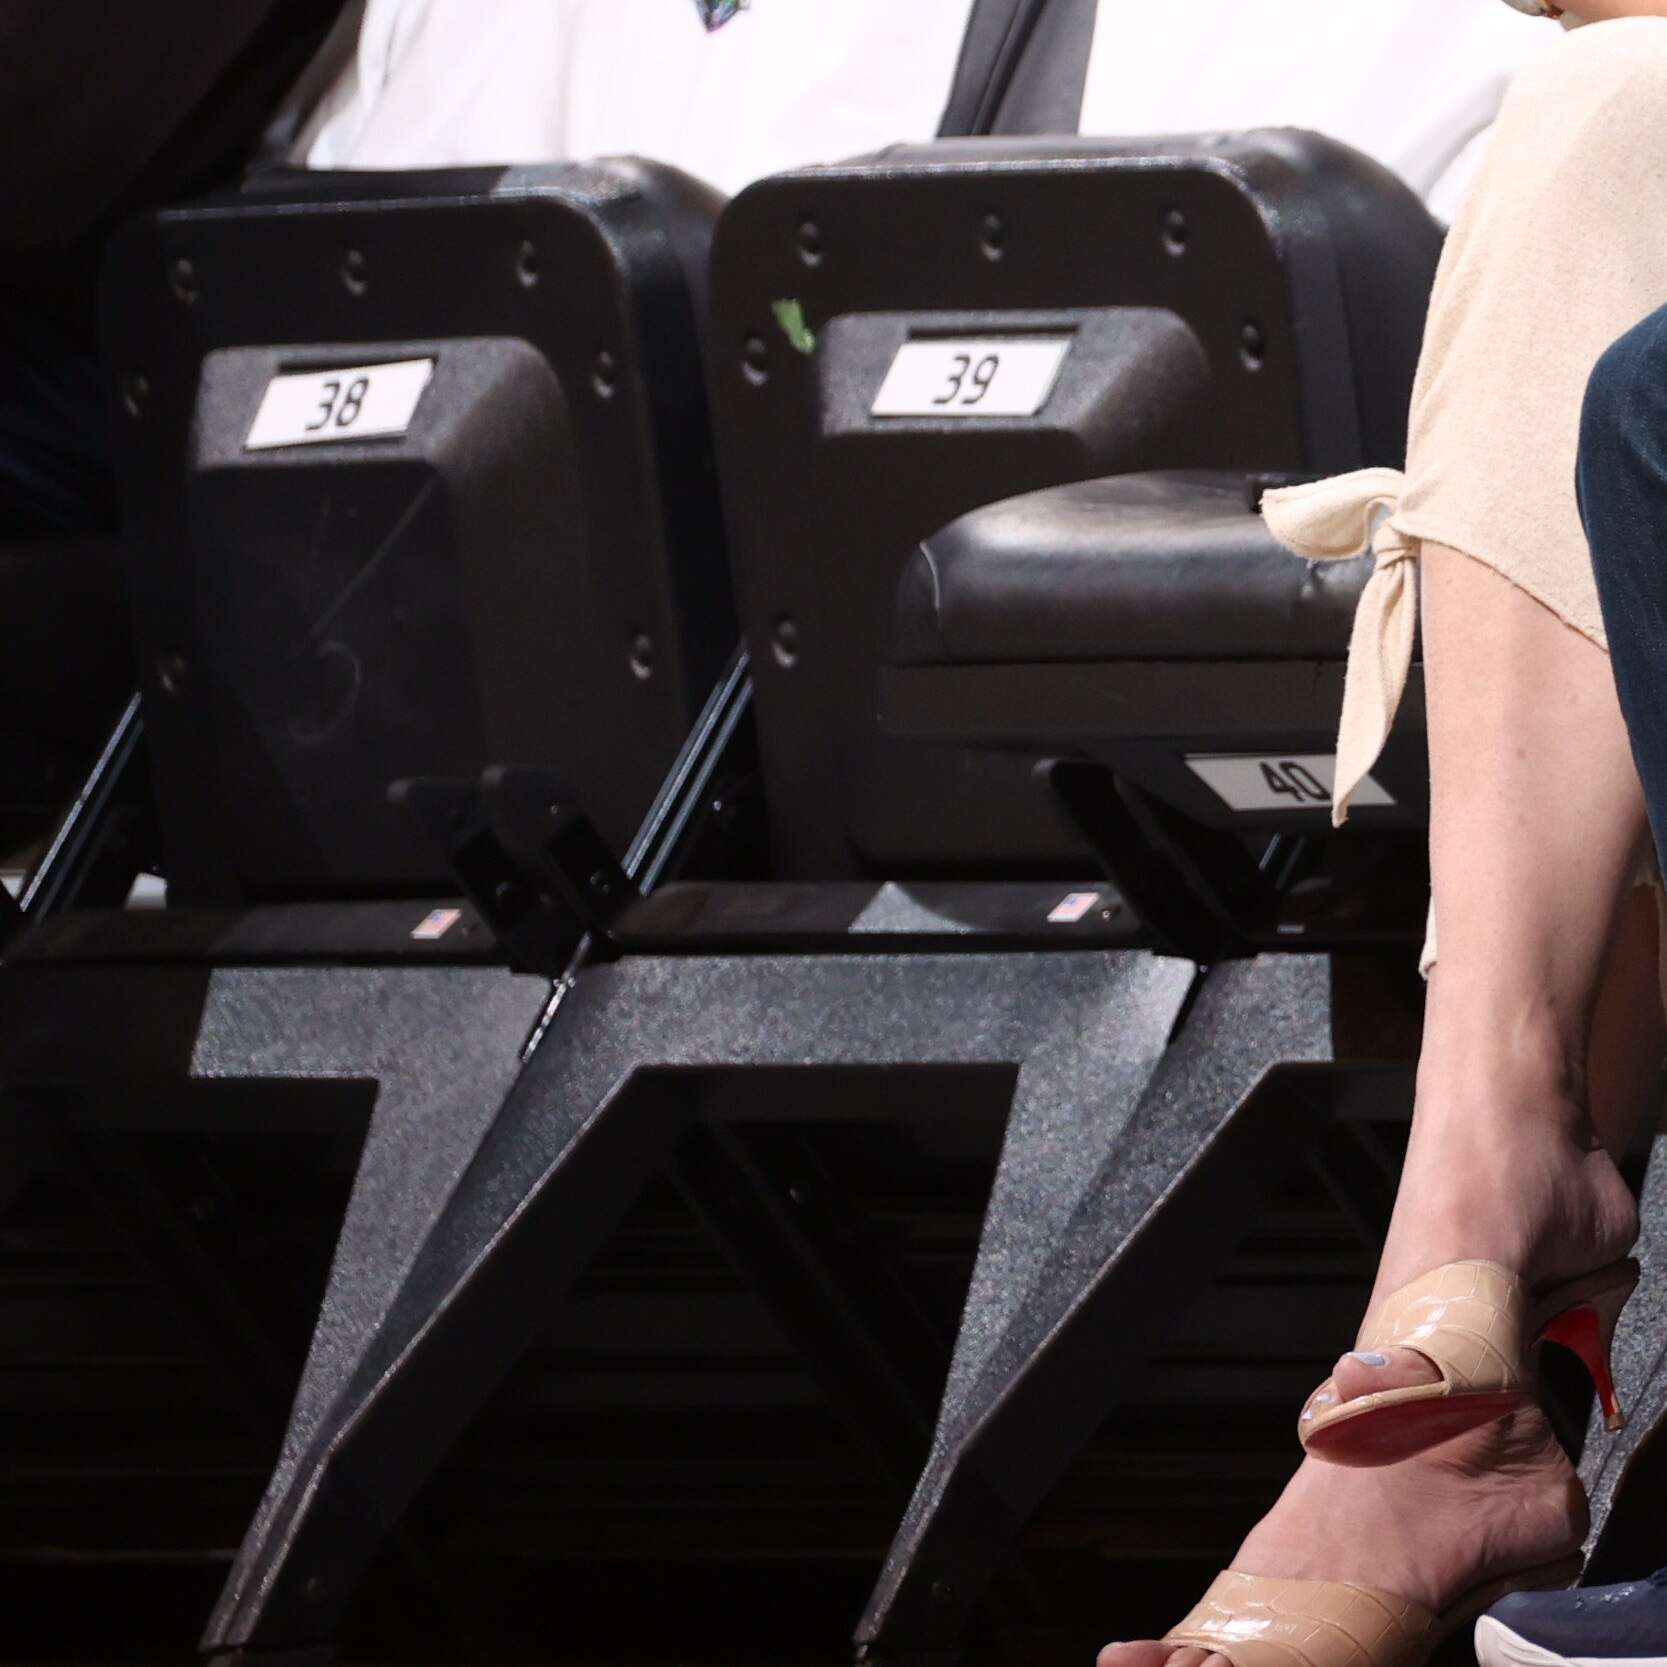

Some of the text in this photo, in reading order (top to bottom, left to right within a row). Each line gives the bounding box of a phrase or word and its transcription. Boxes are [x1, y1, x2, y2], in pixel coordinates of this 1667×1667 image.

[303, 377, 370, 432] 38
[931, 353, 1000, 405] 39
[1258, 761, 1331, 802] 40
